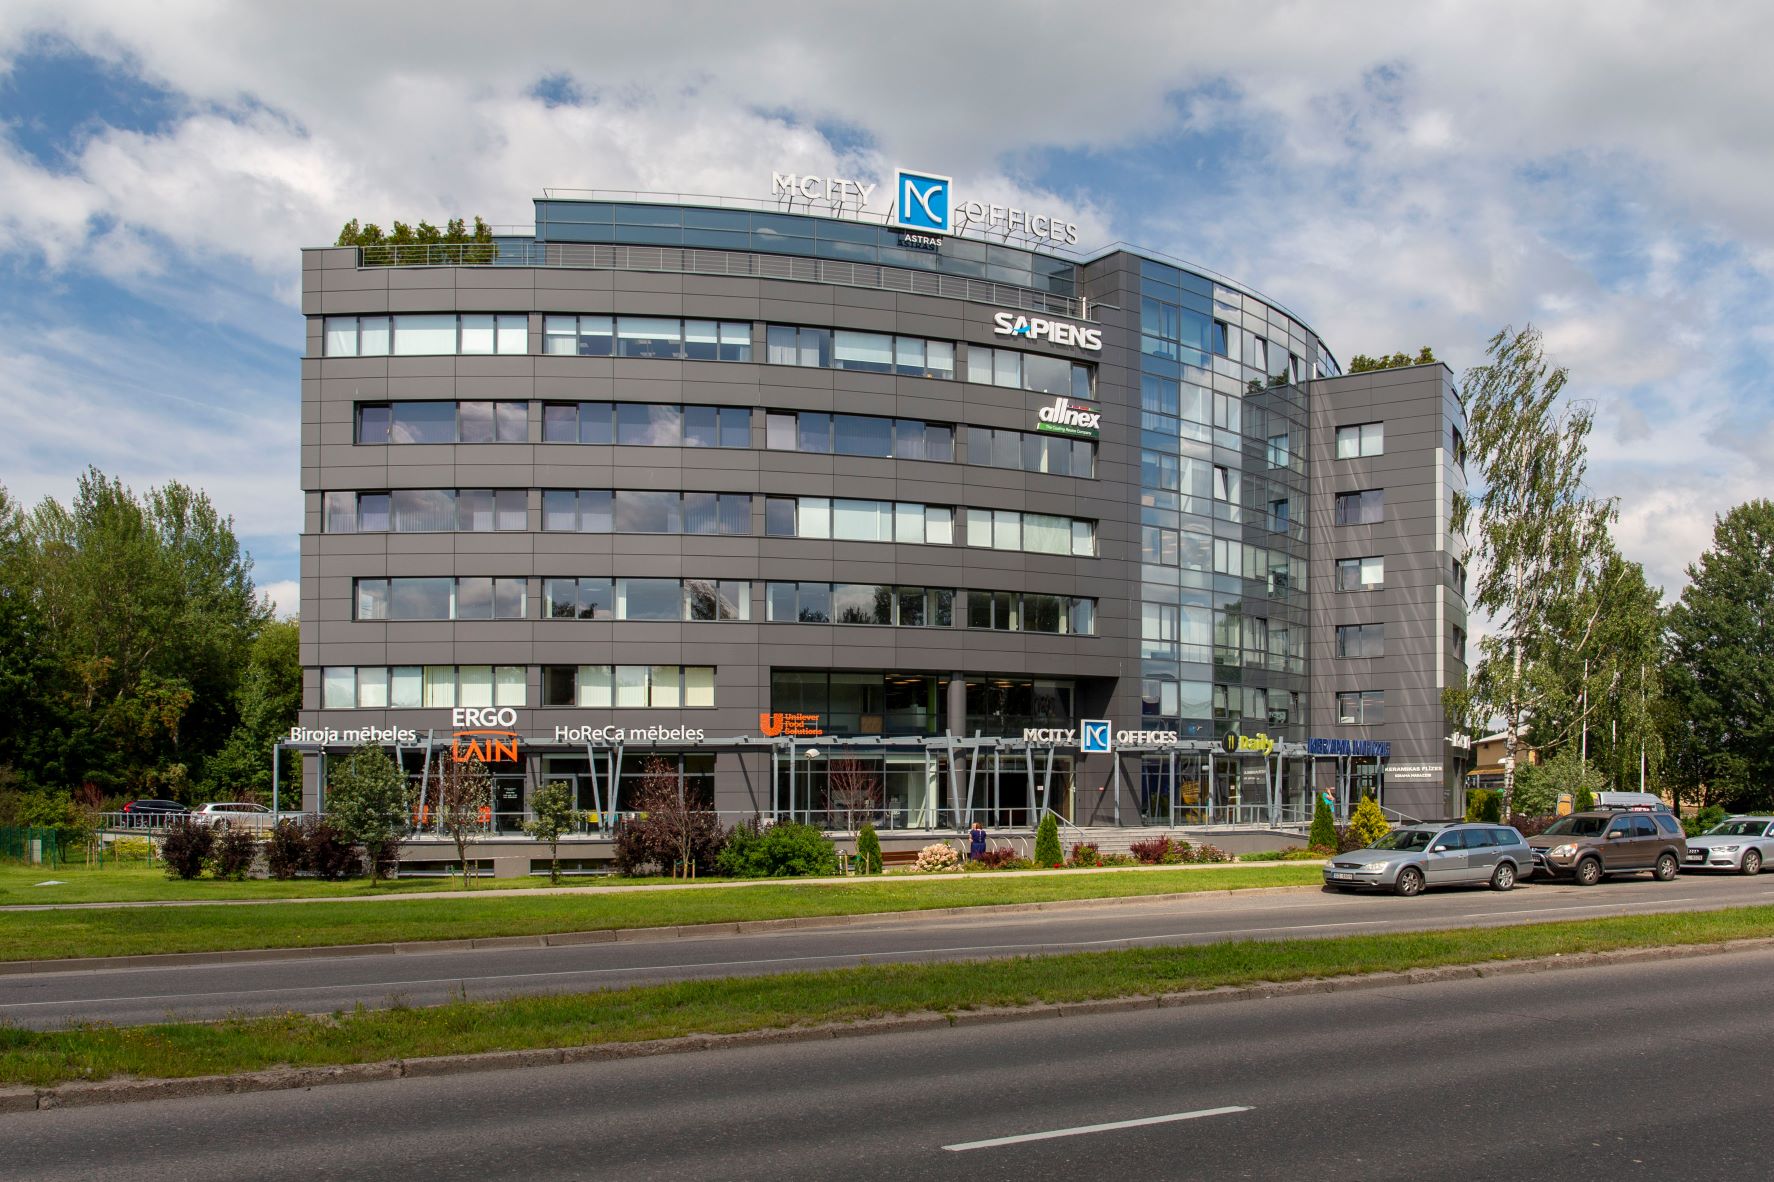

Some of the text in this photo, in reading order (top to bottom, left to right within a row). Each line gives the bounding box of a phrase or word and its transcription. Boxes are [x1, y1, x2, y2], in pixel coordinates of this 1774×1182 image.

[772, 170, 877, 206] MCITY
[964, 200, 1080, 246] OFFICES
[904, 233, 942, 247] ASTRAS
[994, 312, 1102, 350] SAPIENS
[1039, 398, 1100, 429] allnex
[453, 708, 518, 727] ERGO
[290, 726, 417, 745] Biroja mēbeles
[555, 725, 705, 741] HoReCa mēbeles
[1023, 728, 1076, 742] MCITY
[1116, 730, 1178, 744] OFFICES
[453, 739, 518, 762] LAIN
[1239, 732, 1274, 756] Daily
